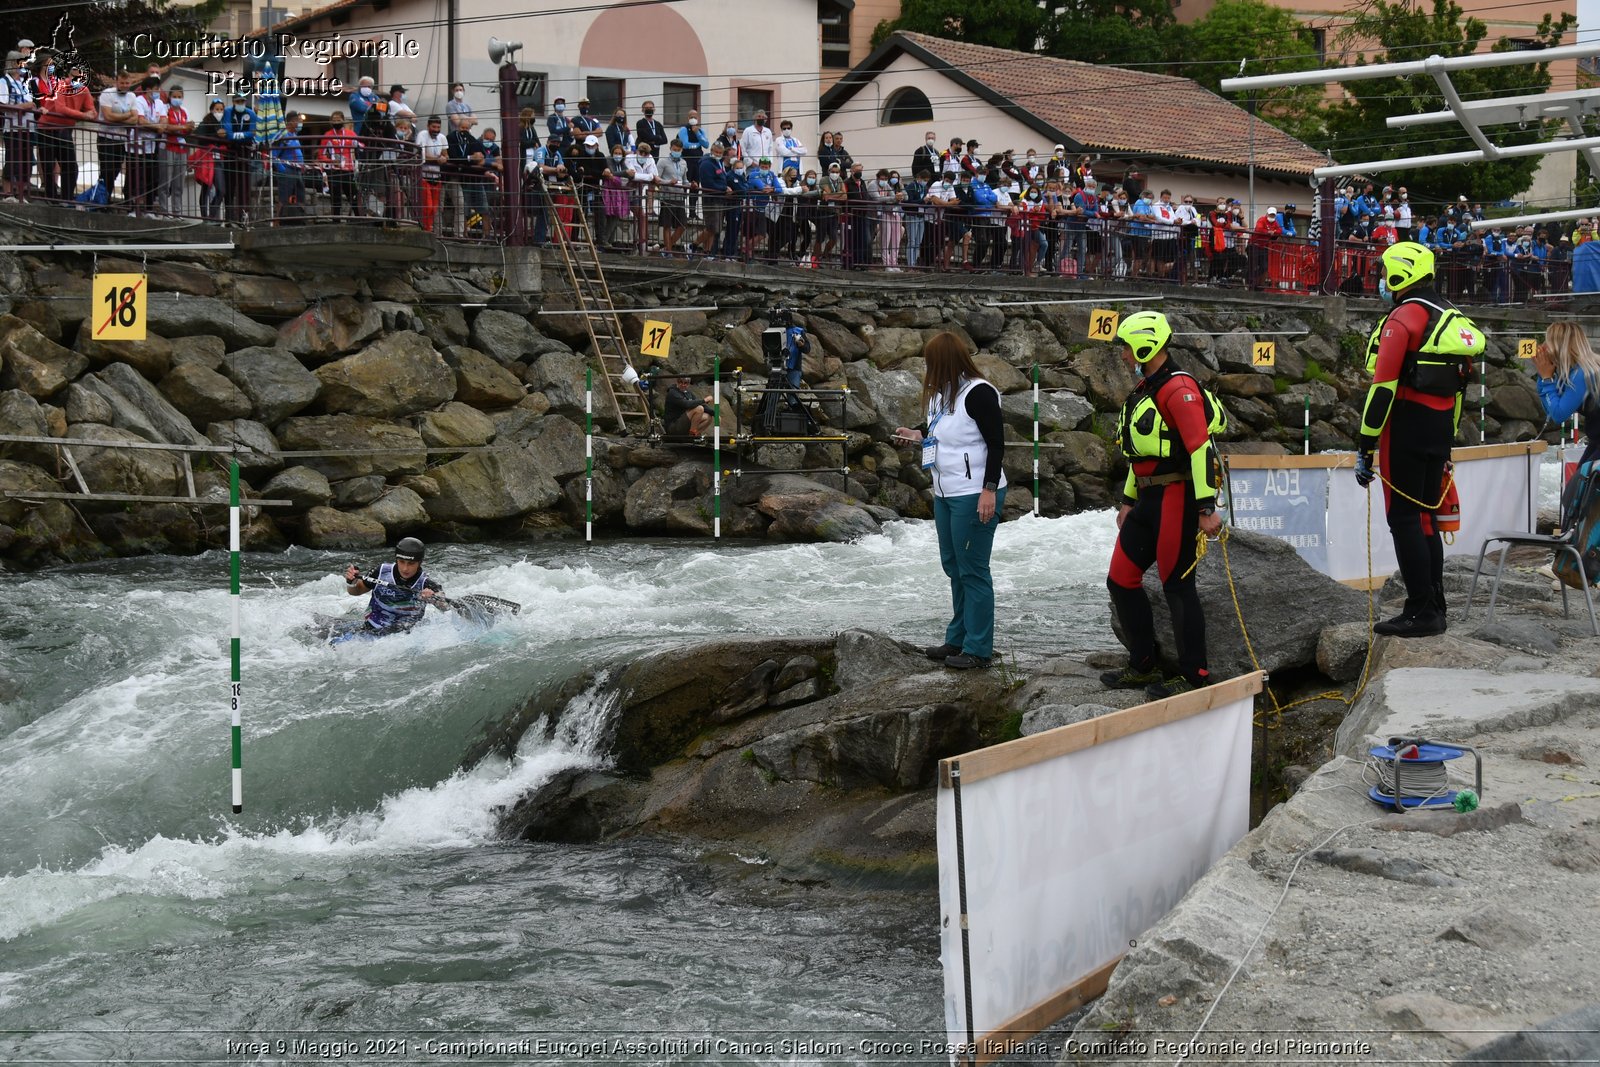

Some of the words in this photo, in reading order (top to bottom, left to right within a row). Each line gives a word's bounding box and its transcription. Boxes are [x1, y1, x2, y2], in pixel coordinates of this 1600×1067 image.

[105, 286, 137, 328] 18
[1096, 315, 1113, 336] 16
[649, 327, 667, 350] 17
[1521, 342, 1533, 355] 13
[1257, 346, 1271, 362] 14
